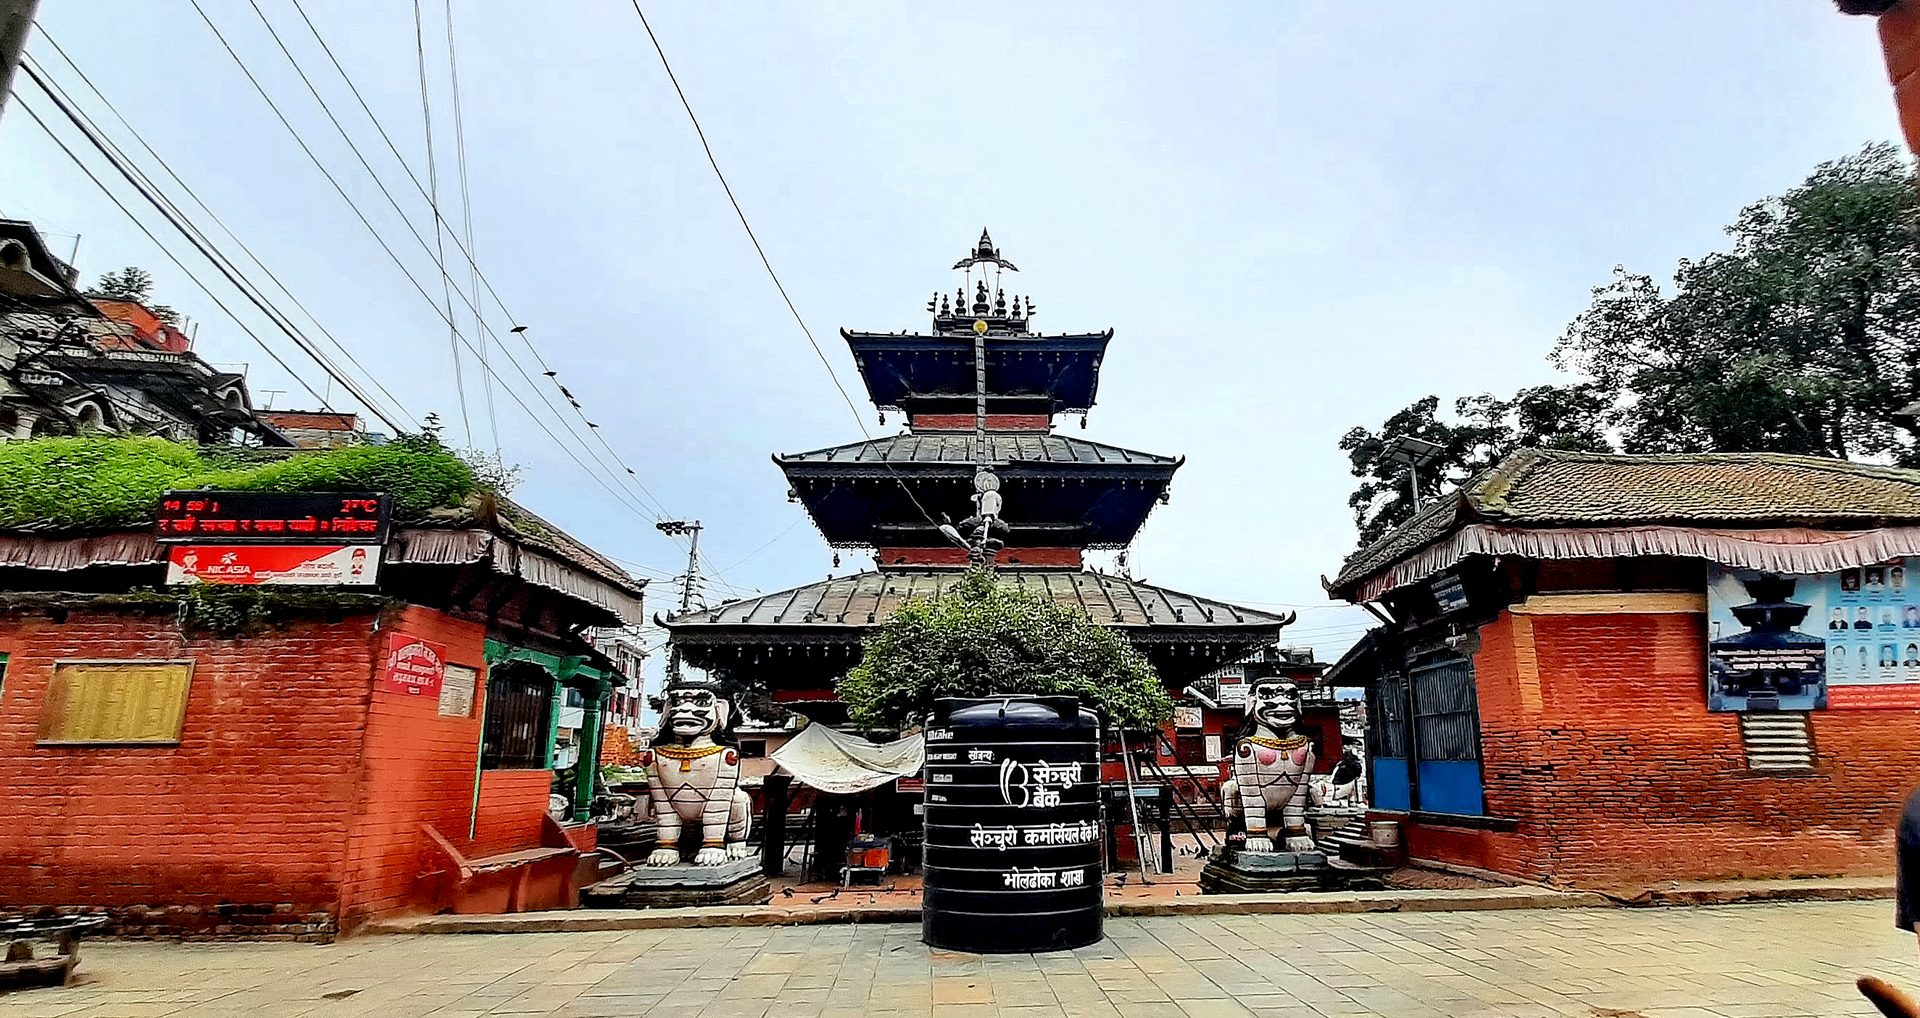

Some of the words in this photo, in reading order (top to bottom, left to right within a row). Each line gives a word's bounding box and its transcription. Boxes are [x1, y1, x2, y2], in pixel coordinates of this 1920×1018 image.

[207, 565, 226, 574] NIC
[227, 565, 251, 574] ASIA
[1032, 784, 1060, 808] बैंक
[1060, 869, 1084, 887] शाखा
